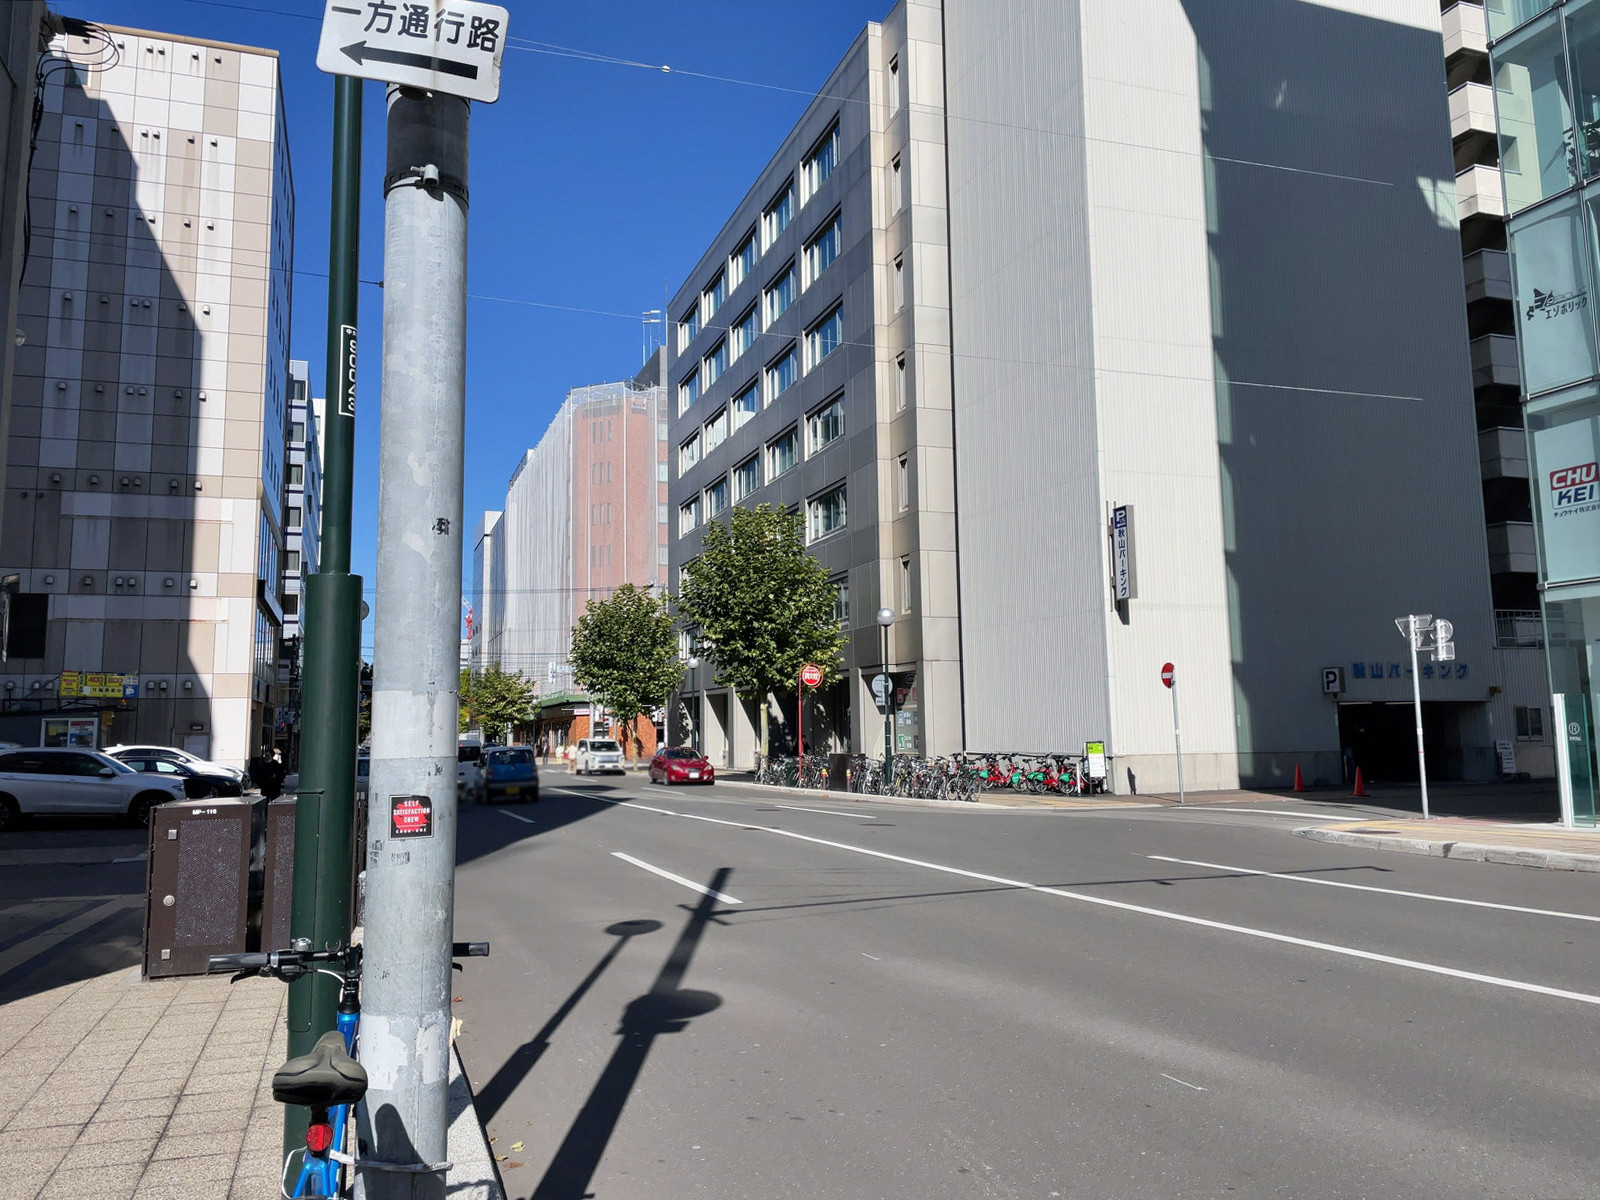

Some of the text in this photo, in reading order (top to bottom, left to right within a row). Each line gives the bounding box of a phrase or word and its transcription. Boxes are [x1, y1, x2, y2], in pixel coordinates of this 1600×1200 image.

[331, 0, 500, 53] 一方通行路
[1552, 465, 1597, 488] CHU
[1557, 484, 1595, 506] KEI
[1325, 670, 1338, 691] P
[393, 807, 430, 816] SATISFACTION
